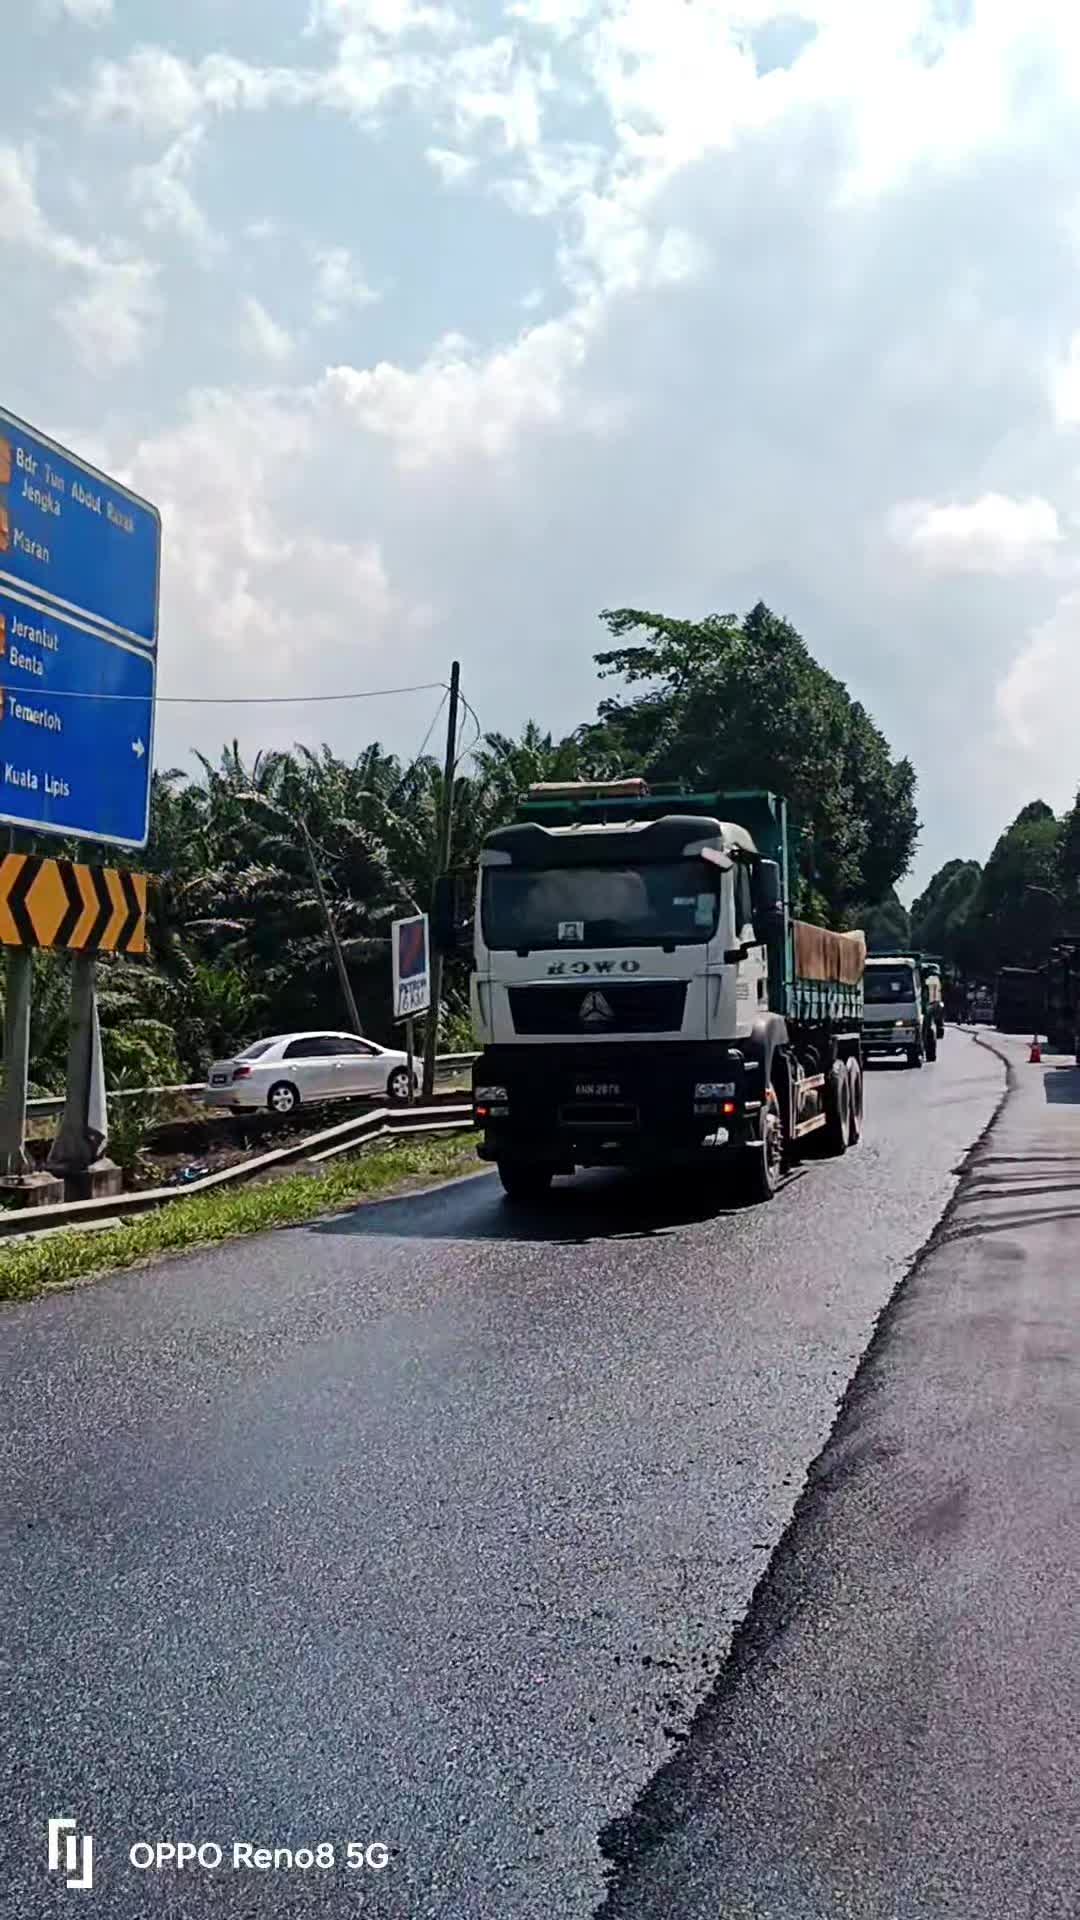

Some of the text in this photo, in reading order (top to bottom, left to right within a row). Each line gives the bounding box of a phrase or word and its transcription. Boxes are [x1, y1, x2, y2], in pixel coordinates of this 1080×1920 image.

[16, 447, 38, 476] Bdr
[72, 480, 102, 515] Abdul
[22, 478, 61, 516] Jengka
[13, 527, 49, 563] Maran
[11, 615, 59, 651] Jerantut
[9, 646, 43, 675] Benta
[9, 696, 62, 732] Temerloh
[4, 763, 70, 797] Kuala Lipis
